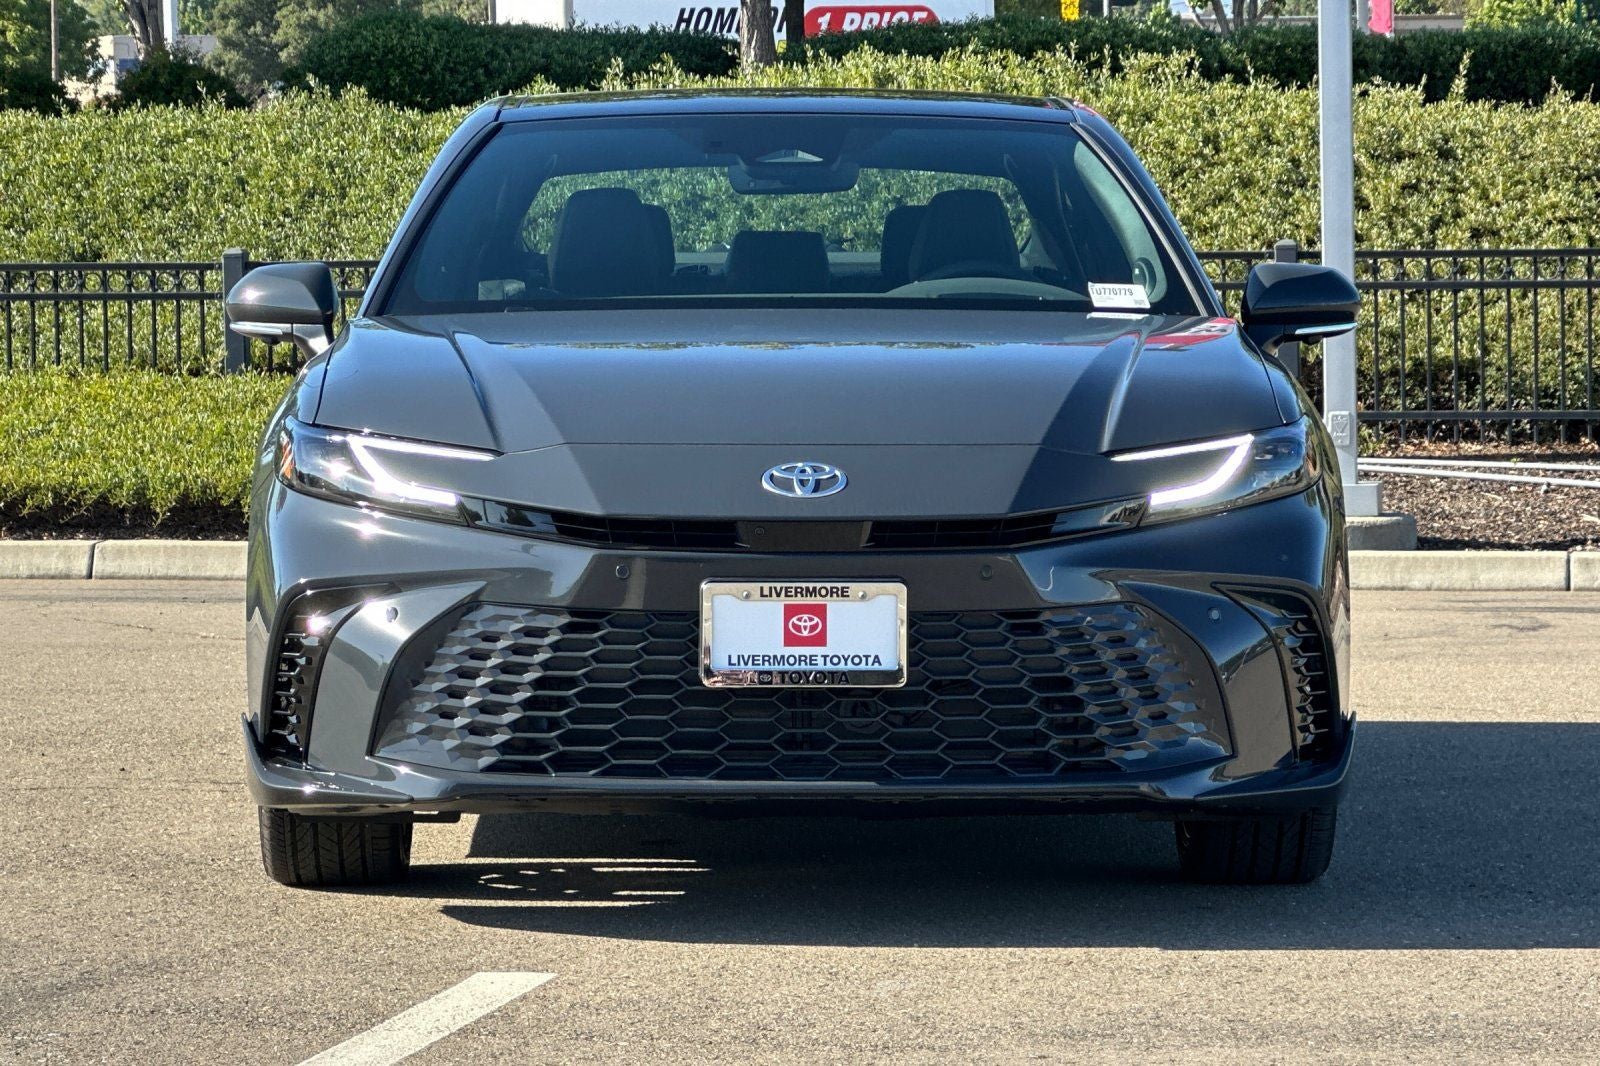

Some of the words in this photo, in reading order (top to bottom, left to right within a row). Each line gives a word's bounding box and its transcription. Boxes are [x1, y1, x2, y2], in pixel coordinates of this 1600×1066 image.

[673, 7, 741, 34] HOM
[817, 12, 831, 35] 1
[759, 586, 850, 598] LIVERMORE
[728, 654, 819, 667] LIVERMORE
[821, 654, 882, 666] TOYOTA
[779, 671, 850, 686] TOYOTA
